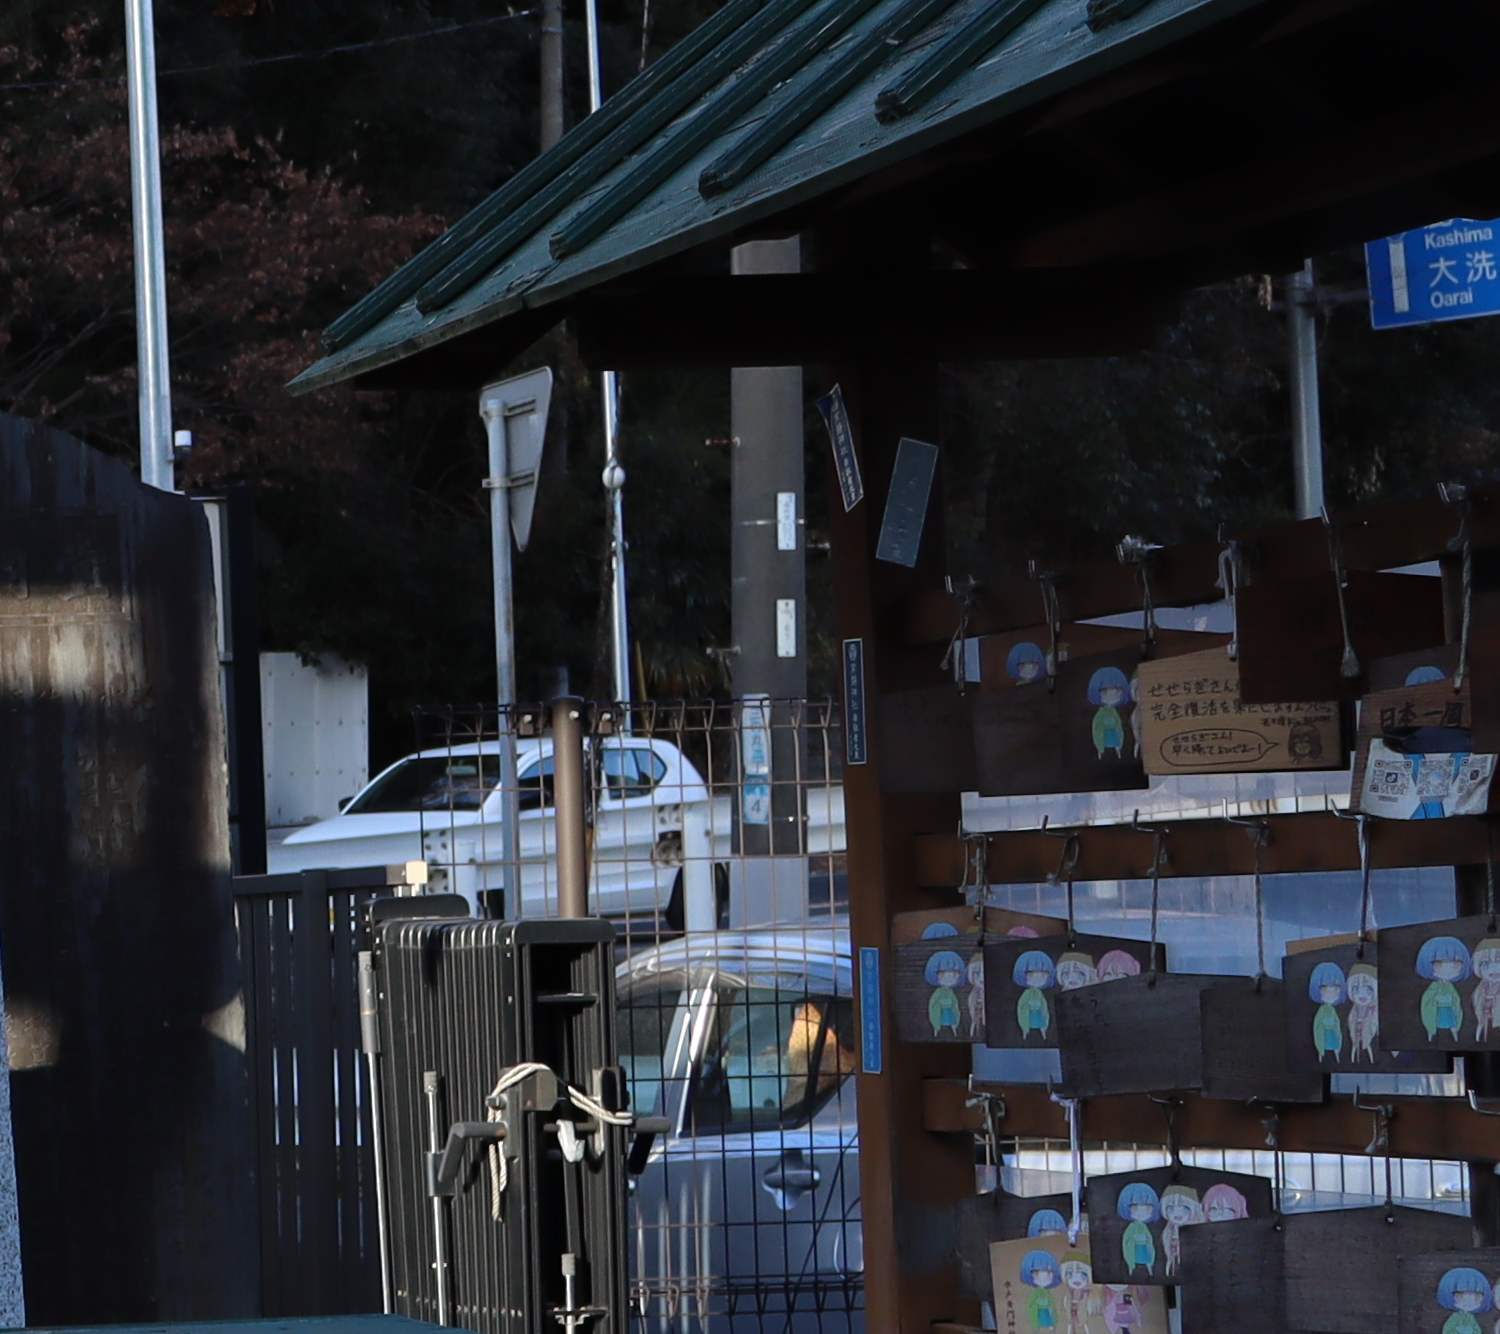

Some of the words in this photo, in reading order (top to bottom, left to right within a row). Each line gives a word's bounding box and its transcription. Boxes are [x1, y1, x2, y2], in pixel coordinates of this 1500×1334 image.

[1424, 227, 1493, 250] Kashima
[1428, 250, 1498, 288] 大洗
[1430, 287, 1473, 309] Oarai
[1148, 679, 1240, 698] せせらぎさん
